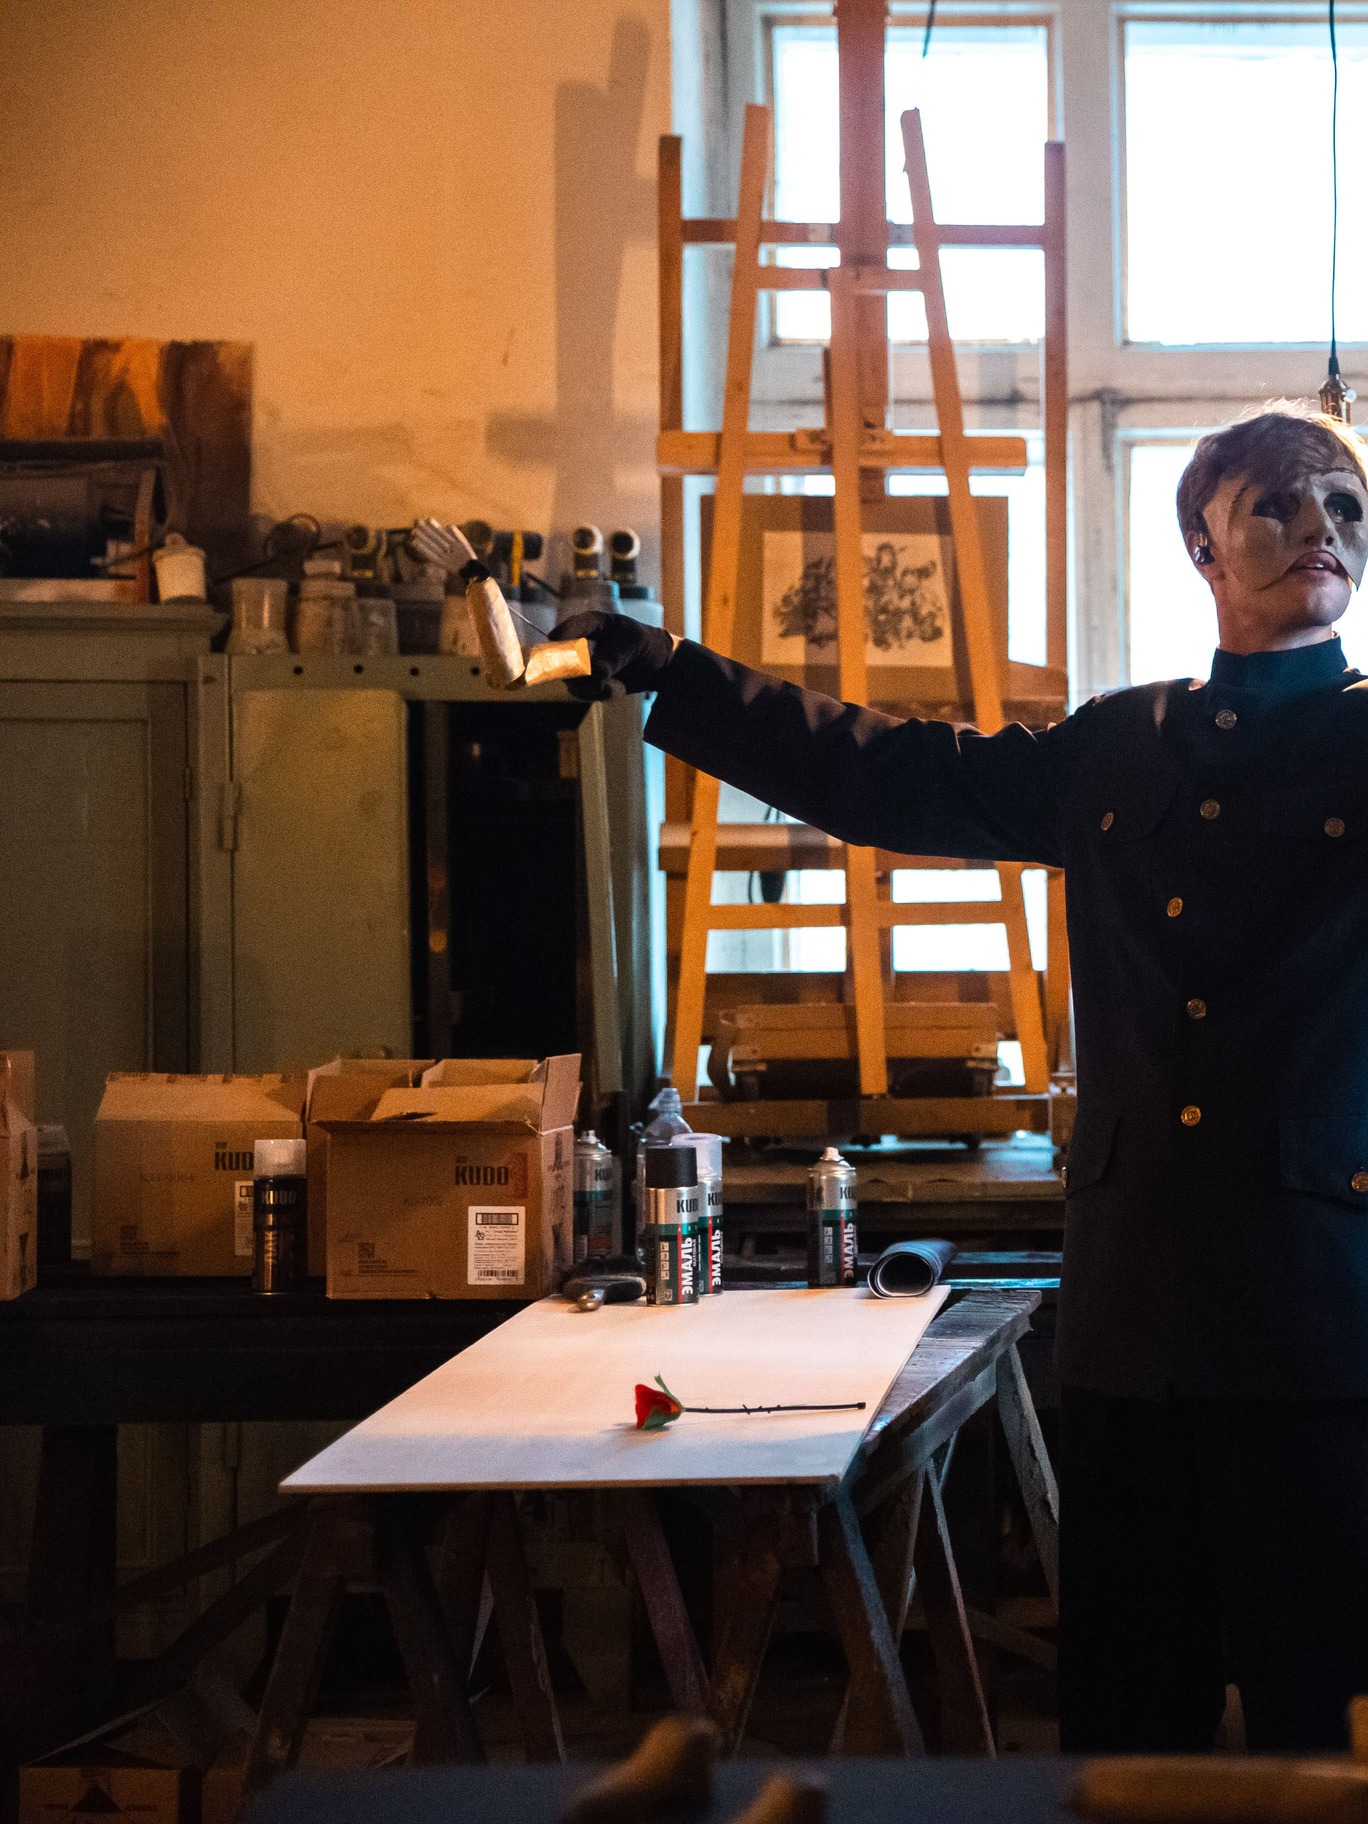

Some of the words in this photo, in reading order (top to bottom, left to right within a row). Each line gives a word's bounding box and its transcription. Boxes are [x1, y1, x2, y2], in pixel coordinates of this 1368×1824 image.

[214, 1152, 254, 1171] KUD
[454, 1165, 509, 1186] KUDO
[261, 1190, 297, 1205] KUDO
[676, 1198, 699, 1213] KUD
[711, 1229, 722, 1286] ЭМАЛЬ
[844, 1222, 854, 1278] ЭМАЛЬ
[681, 1237, 693, 1295] ЭМАЛЬ
